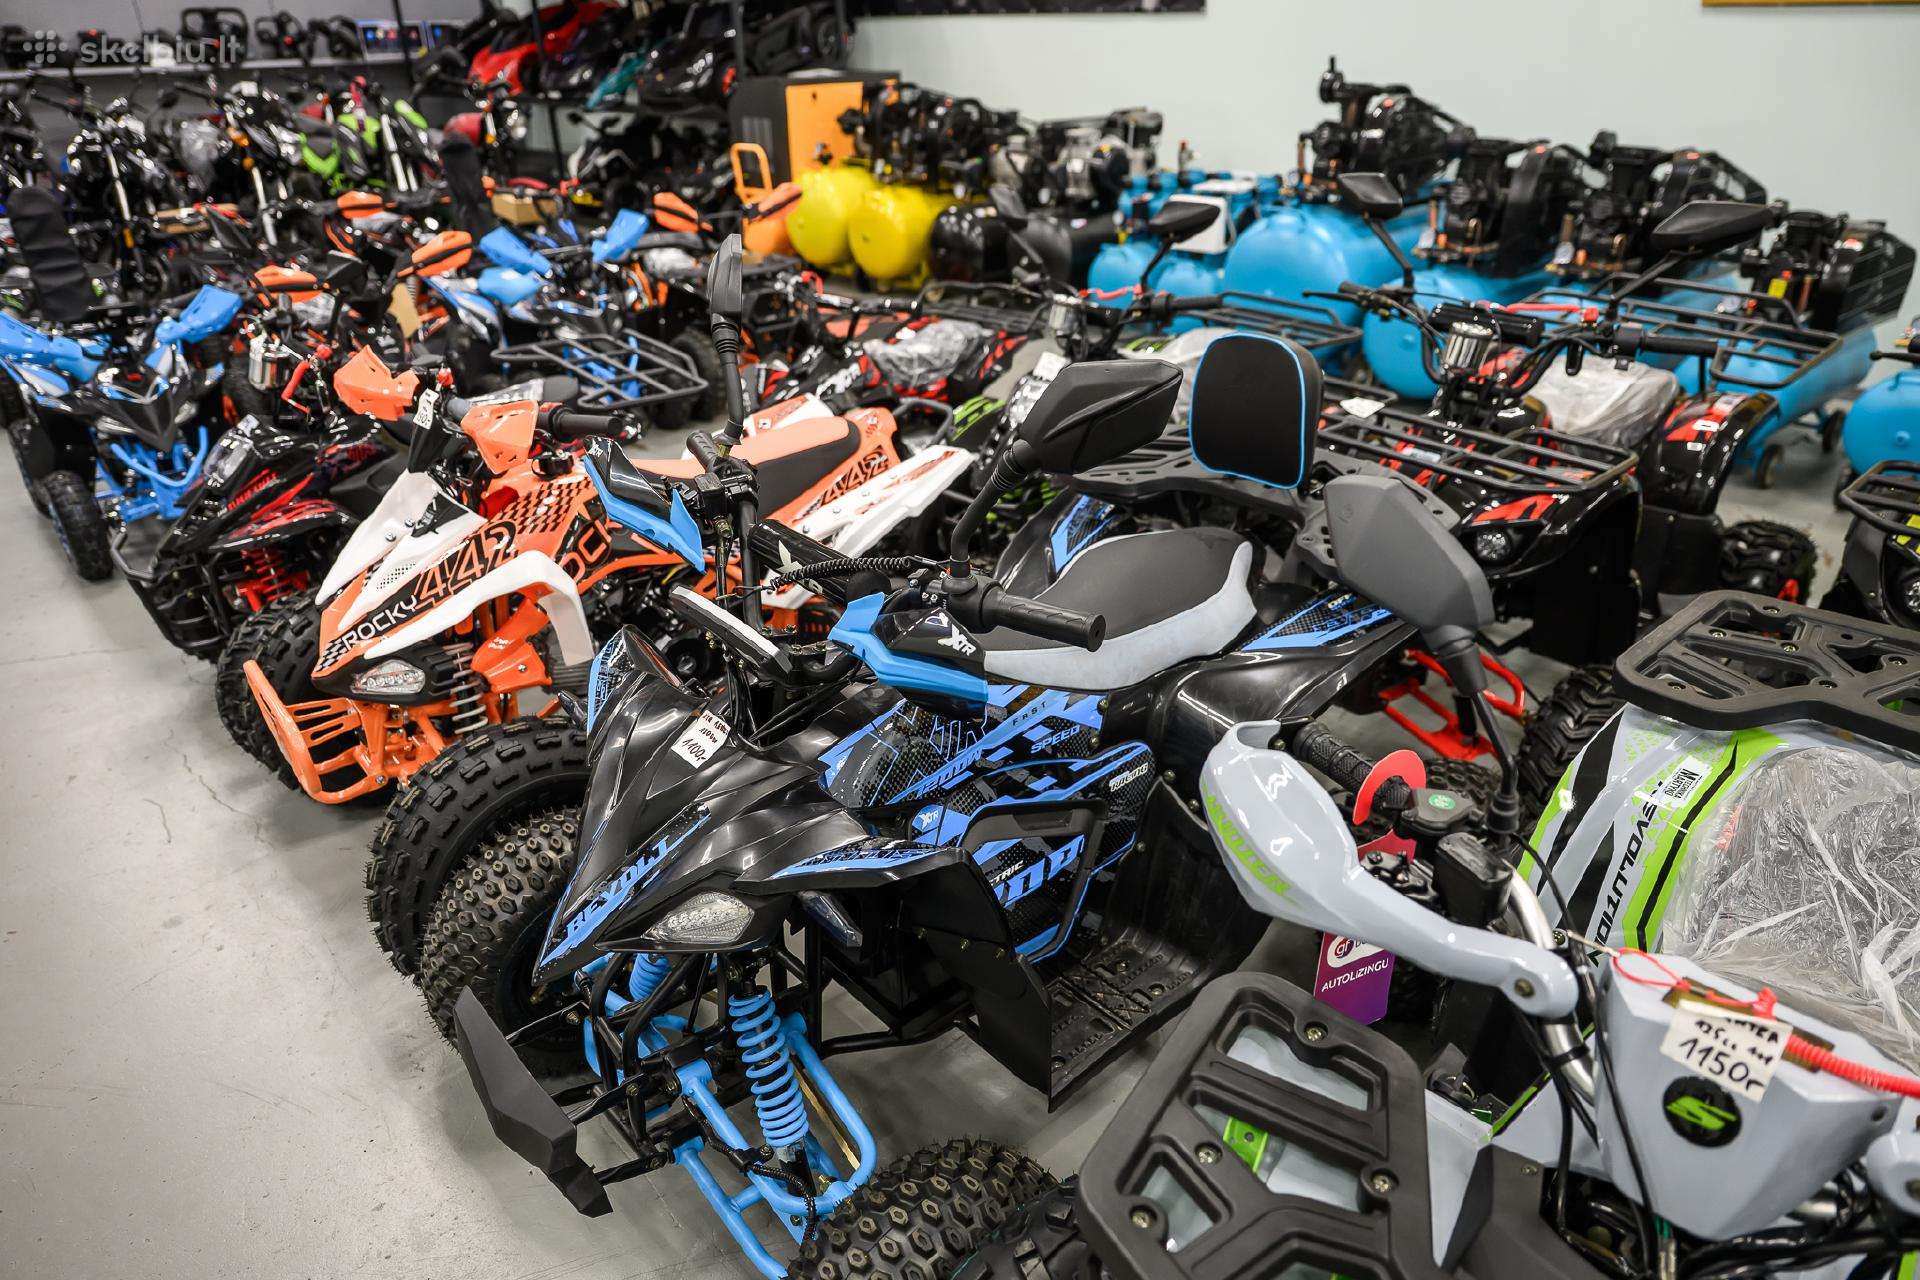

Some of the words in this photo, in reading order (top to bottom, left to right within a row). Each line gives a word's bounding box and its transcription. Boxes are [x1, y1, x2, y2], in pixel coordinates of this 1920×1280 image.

[415, 522, 517, 605] 442
[344, 594, 419, 652] ROCKY
[938, 624, 977, 656] XTR
[1011, 701, 1047, 727] FAST
[1031, 725, 1081, 754] SPEED
[919, 810, 939, 829] XTR
[566, 835, 670, 935] REVOLT
[1587, 782, 1661, 968] EVOLUTION
[1321, 958, 1390, 992] AUTOLIZINGU
